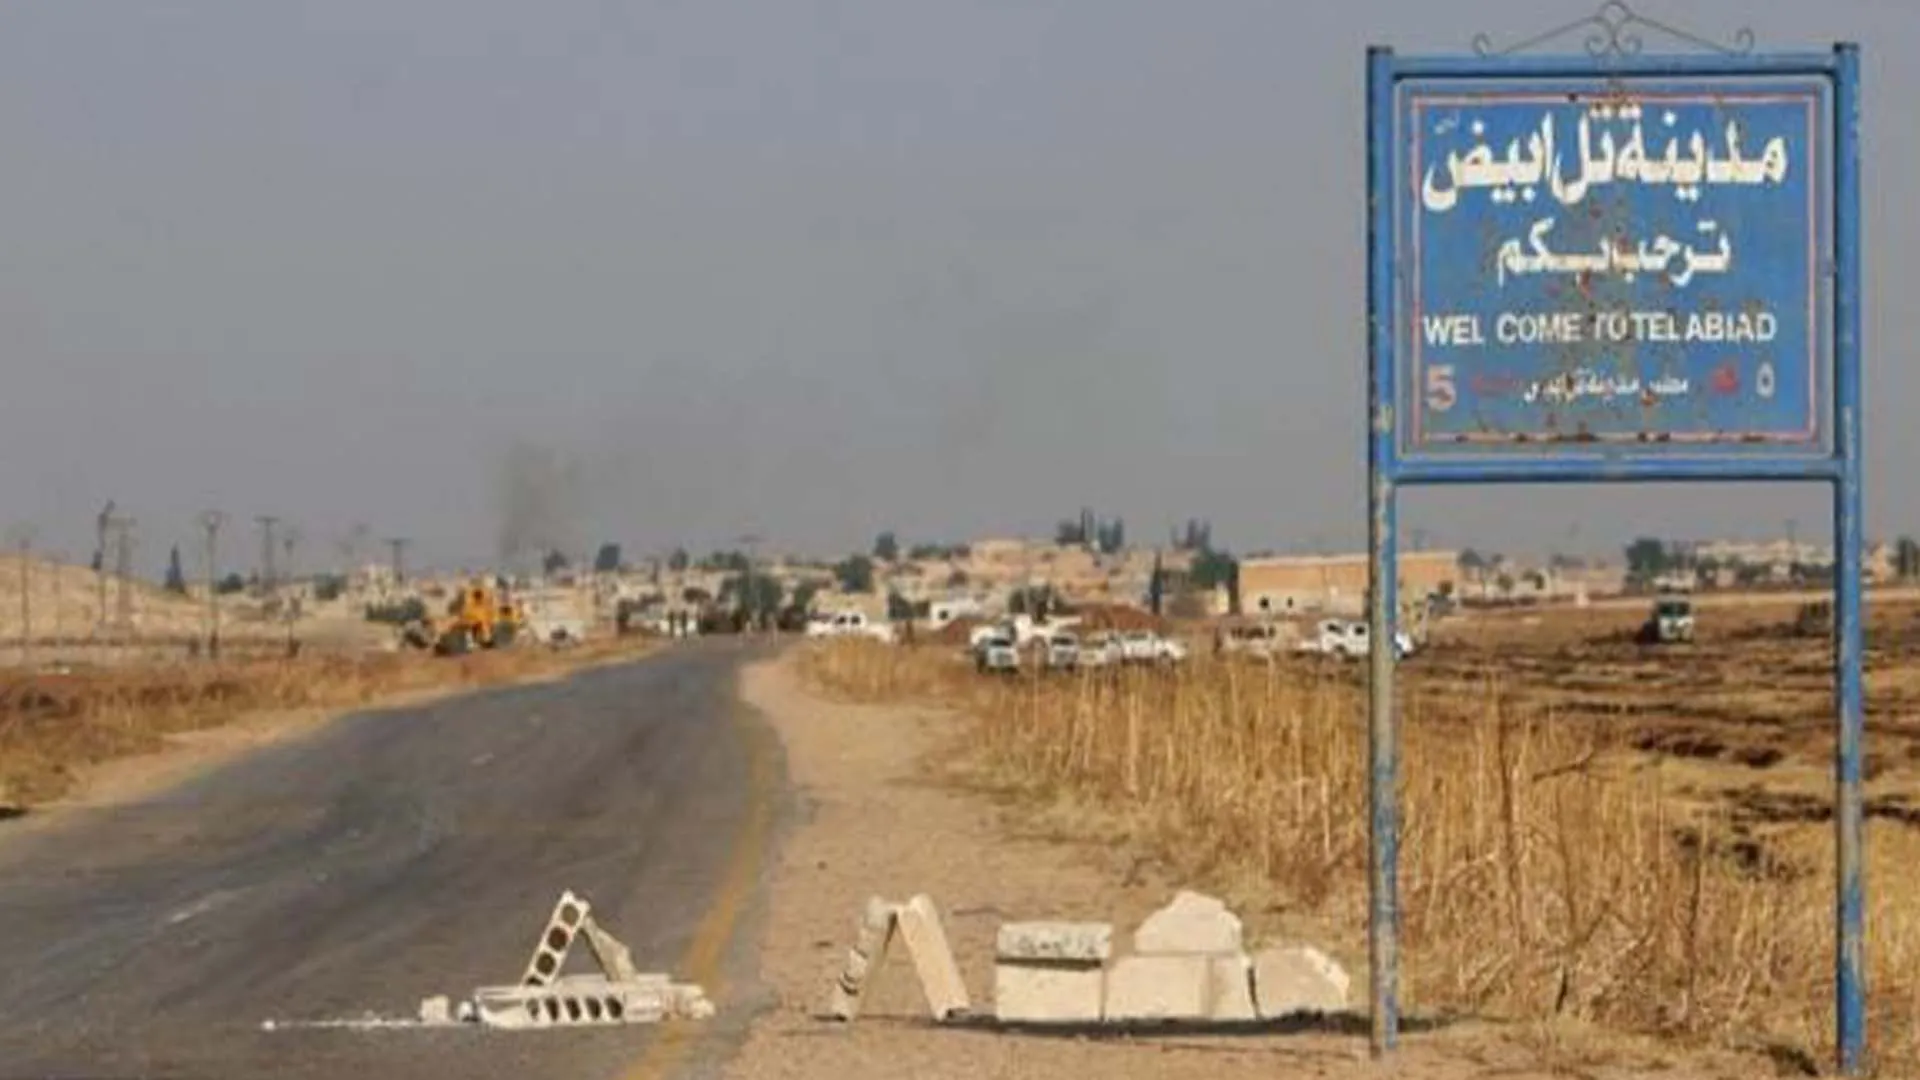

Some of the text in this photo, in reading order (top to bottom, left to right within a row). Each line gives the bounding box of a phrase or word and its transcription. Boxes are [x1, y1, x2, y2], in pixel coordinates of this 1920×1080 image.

[1551, 104, 1614, 204] تل
[1617, 104, 1788, 202] مدينة
[1498, 217, 1732, 288] ترحب بكم
[1594, 312, 1628, 341] TO
[1630, 313, 1681, 341] TEL
[1685, 313, 1778, 342] ABIAD
[1428, 365, 1456, 411] 5
